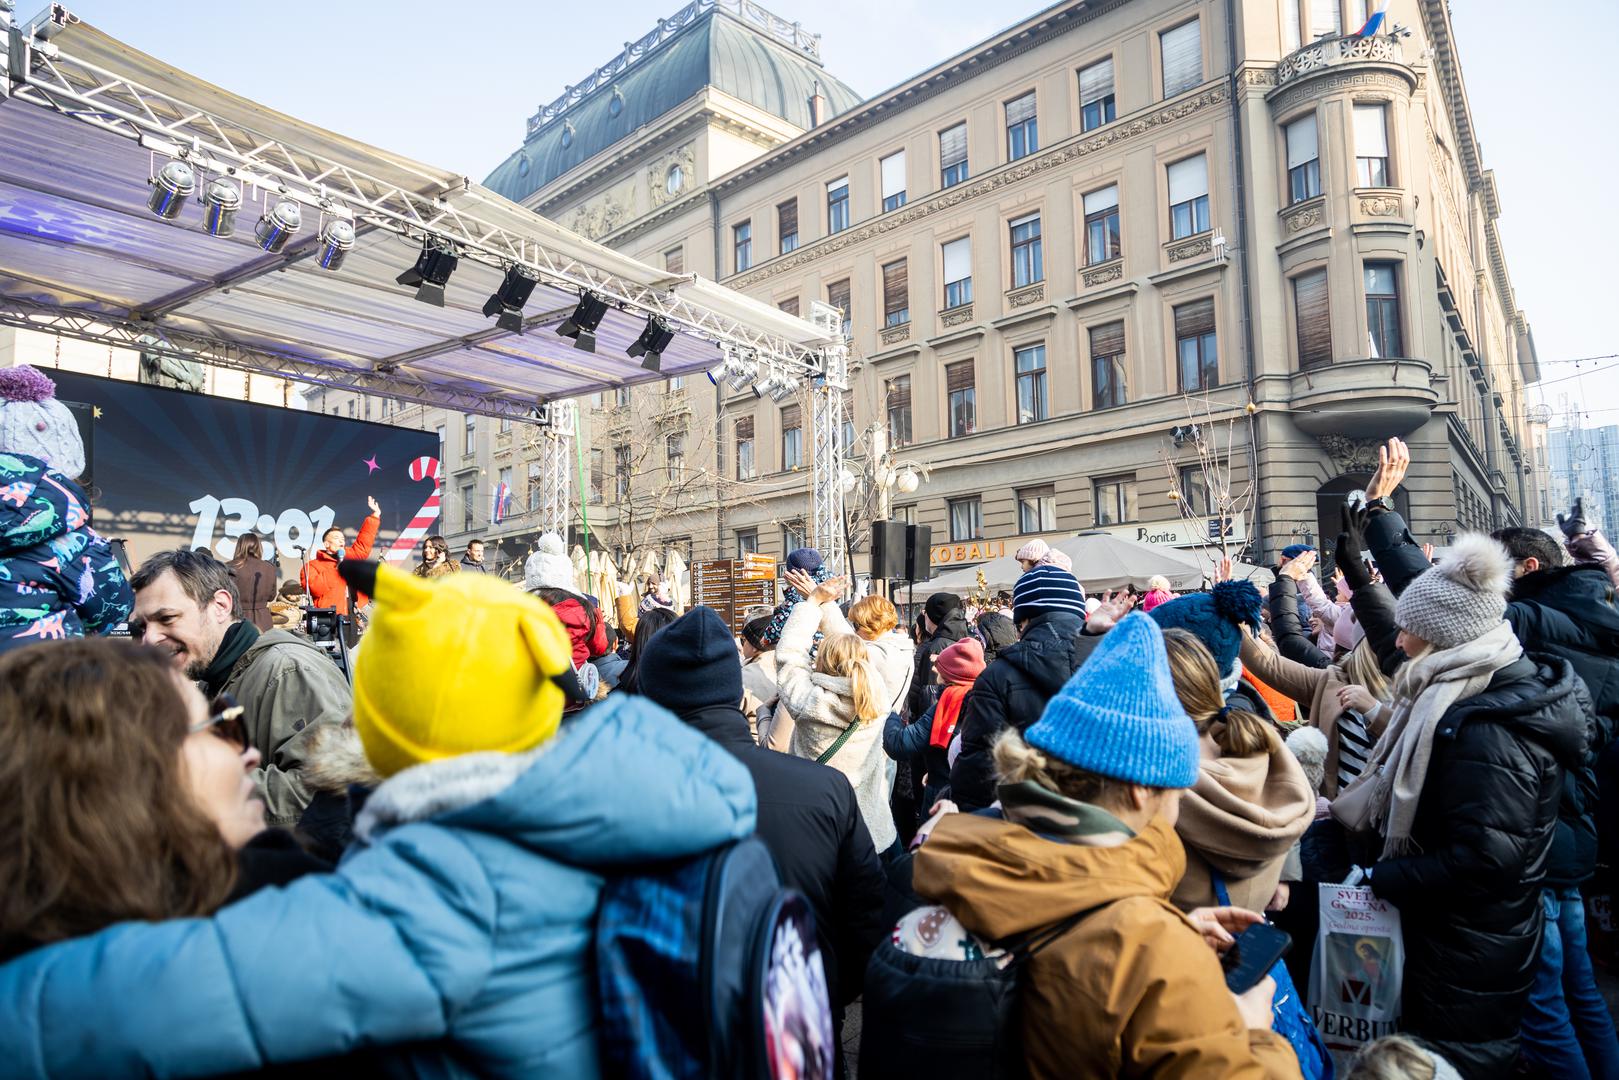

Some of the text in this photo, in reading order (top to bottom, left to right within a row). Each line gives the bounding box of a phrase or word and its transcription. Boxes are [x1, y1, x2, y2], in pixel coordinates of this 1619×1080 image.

[189, 494, 336, 561] 13:01
[1137, 527, 1177, 544] Bonita
[930, 542, 1005, 564] KOBALI
[1345, 911, 1375, 921] 2025.
